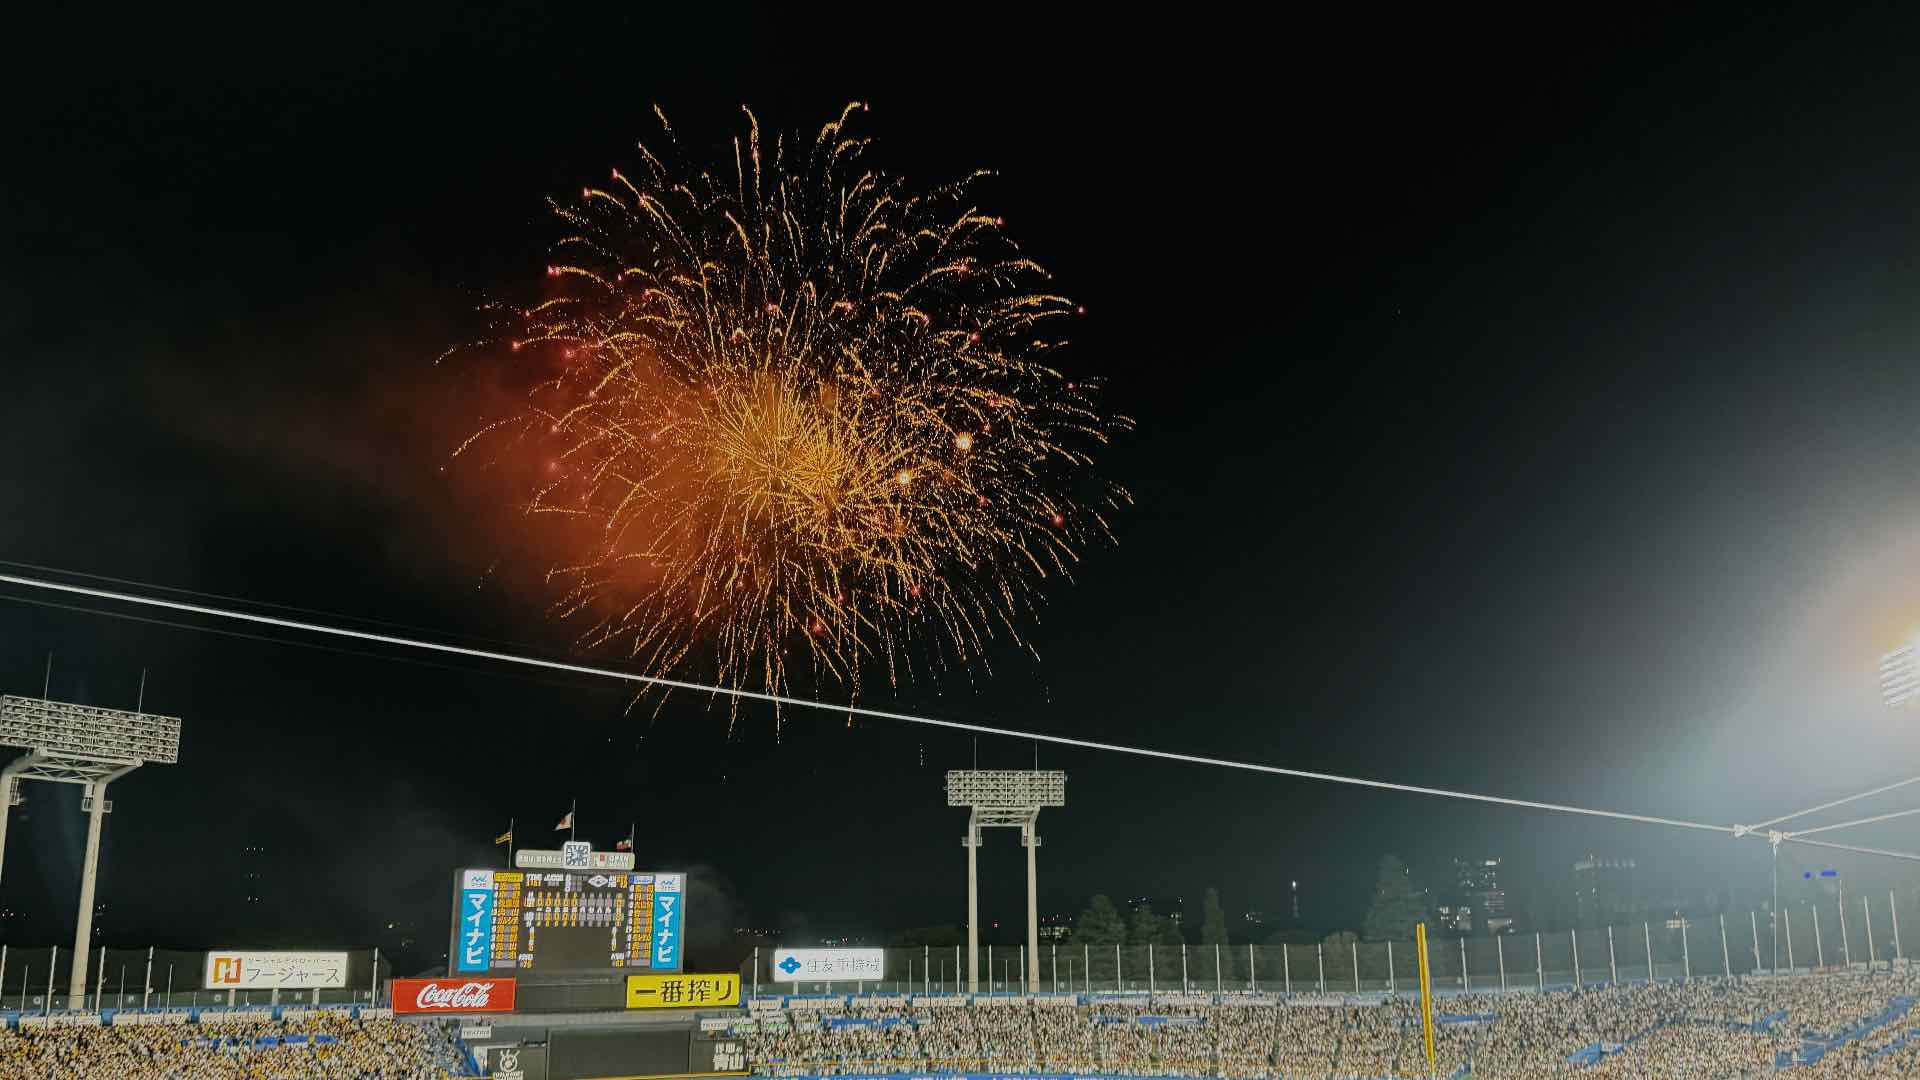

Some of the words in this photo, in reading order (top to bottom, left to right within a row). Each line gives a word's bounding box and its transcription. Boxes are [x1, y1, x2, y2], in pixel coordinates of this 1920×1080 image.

[466, 894, 487, 964] マイナビ
[658, 896, 676, 963] マイナビ
[246, 965, 340, 983] フージャース
[416, 982, 495, 1008] Coca-Cola
[635, 979, 732, 1003] 一番搾り
[713, 1053, 744, 1072] 青山
